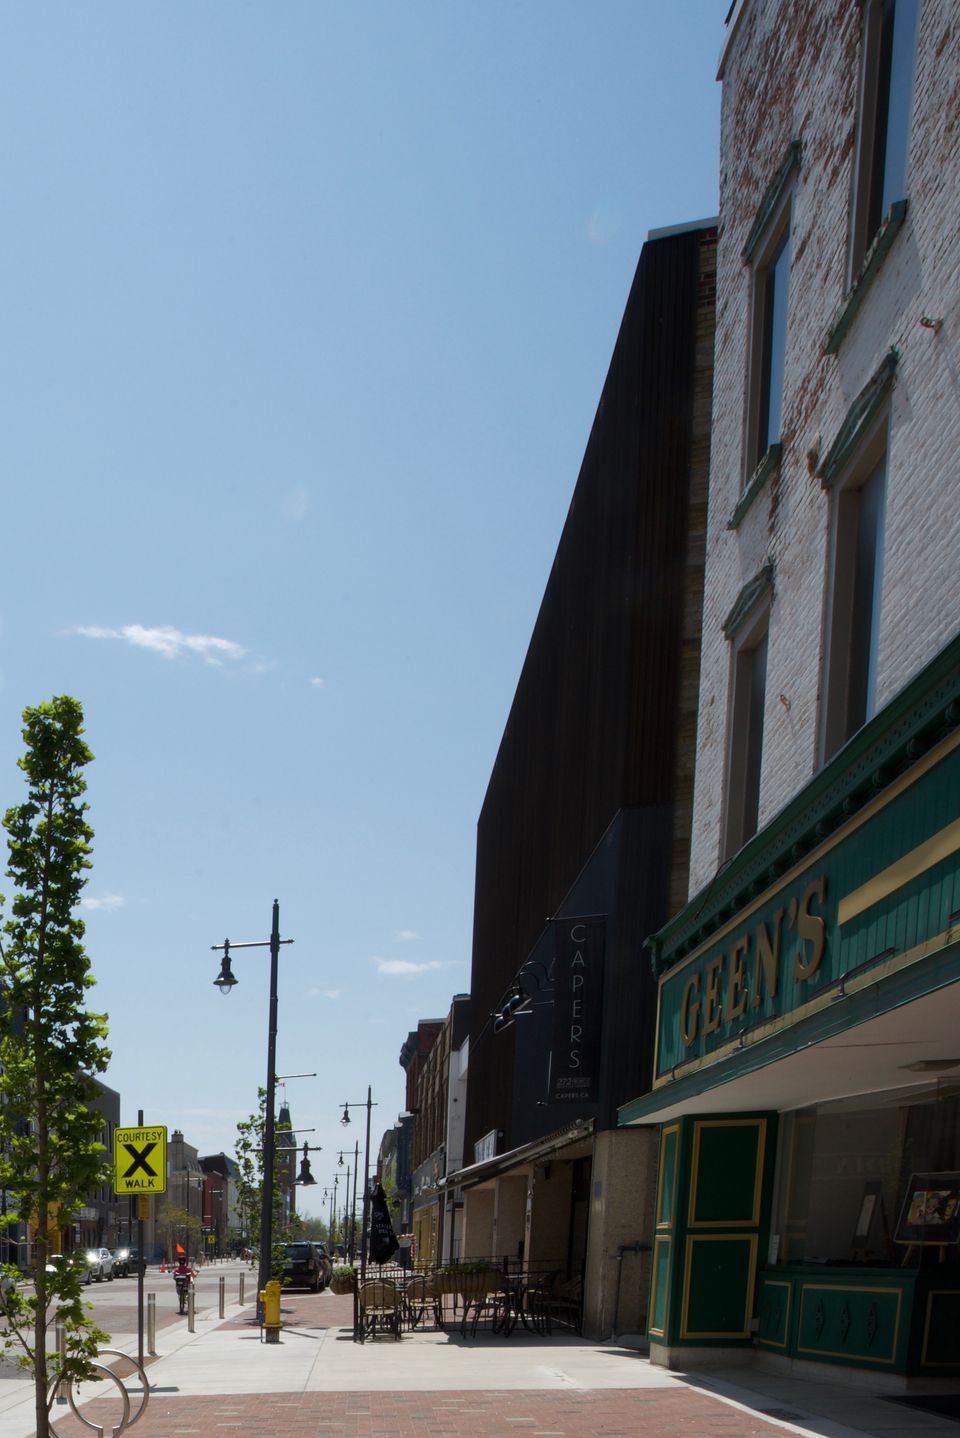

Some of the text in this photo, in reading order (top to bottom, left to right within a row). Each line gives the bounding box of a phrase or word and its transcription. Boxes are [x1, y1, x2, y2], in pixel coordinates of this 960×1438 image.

[568, 924, 586, 1068] CAPERS
[680, 874, 827, 1047] GEEN'S
[117, 1131, 163, 1143] COURTESY
[125, 1178, 155, 1189] WALK
